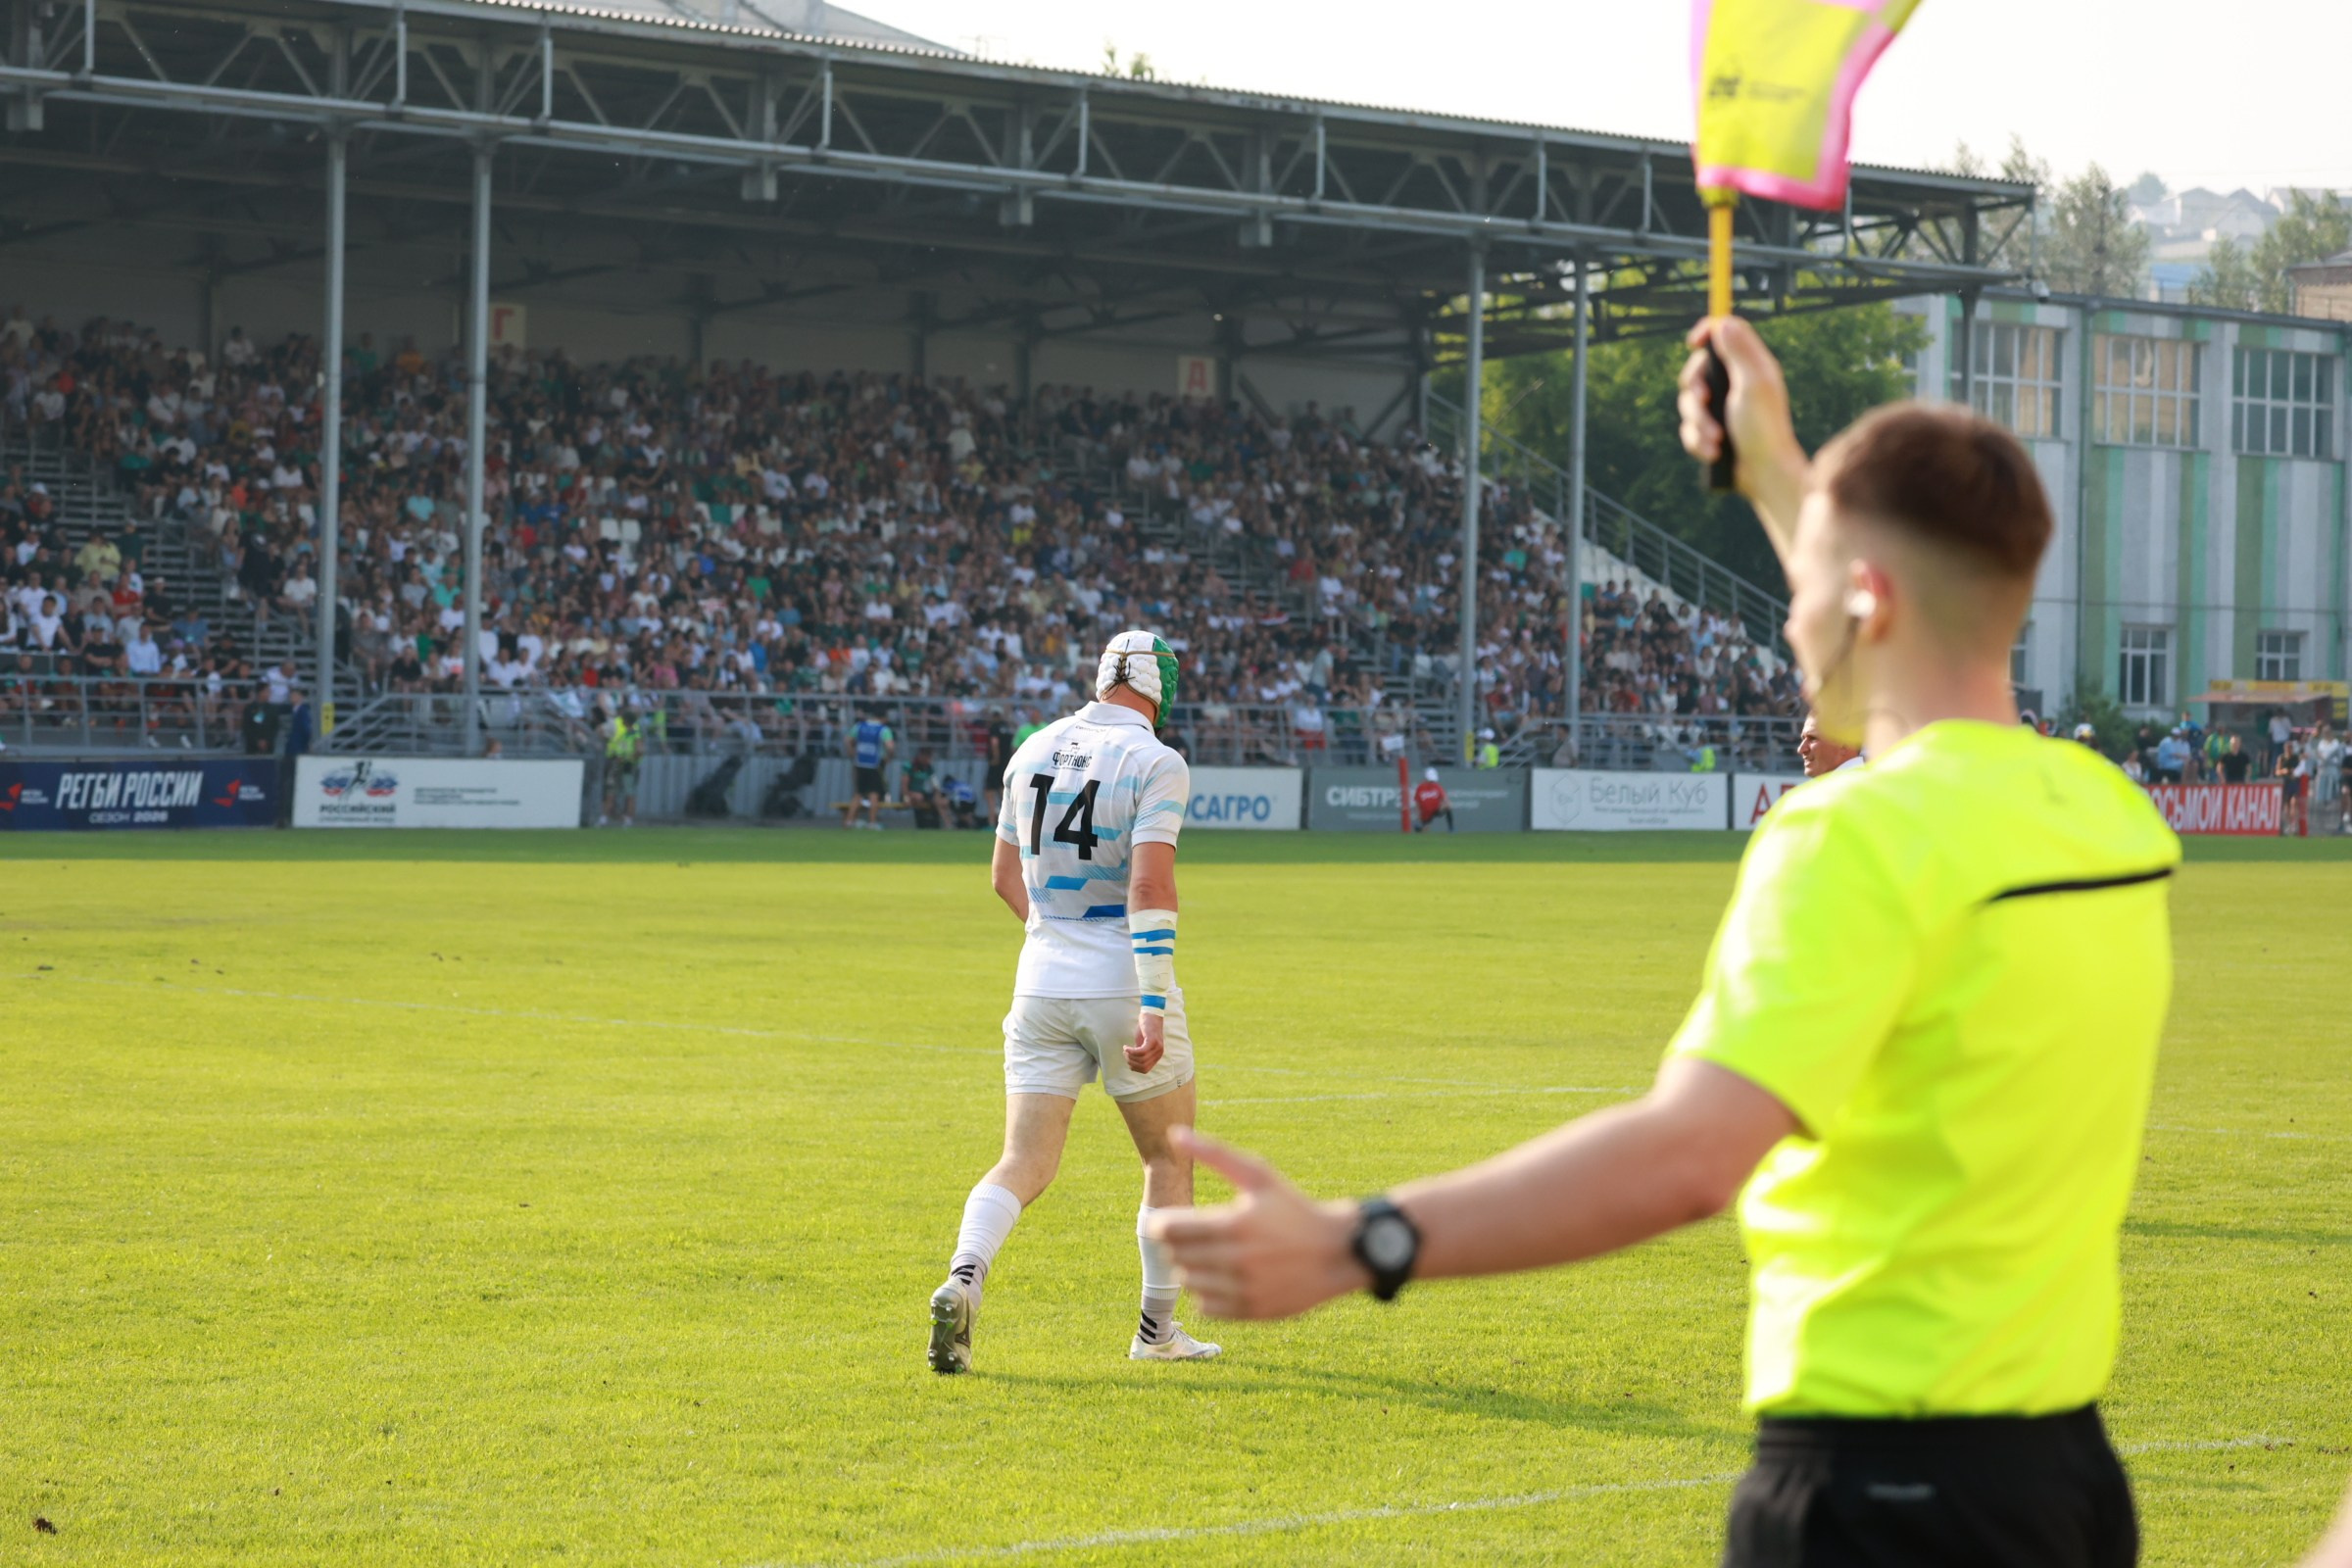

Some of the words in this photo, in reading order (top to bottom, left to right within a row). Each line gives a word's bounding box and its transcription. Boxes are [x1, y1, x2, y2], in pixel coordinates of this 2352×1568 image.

[56, 772, 122, 808] РЕГБИ
[122, 770, 204, 808] РОССИИ
[1187, 795, 1271, 820] САГРО
[1590, 776, 1660, 805] Белый
[1668, 780, 1709, 808] Куб
[1030, 773, 1101, 860] 14
[2148, 786, 2223, 831] ОСЬМОЙ
[2226, 786, 2282, 830] КАНАЛ
